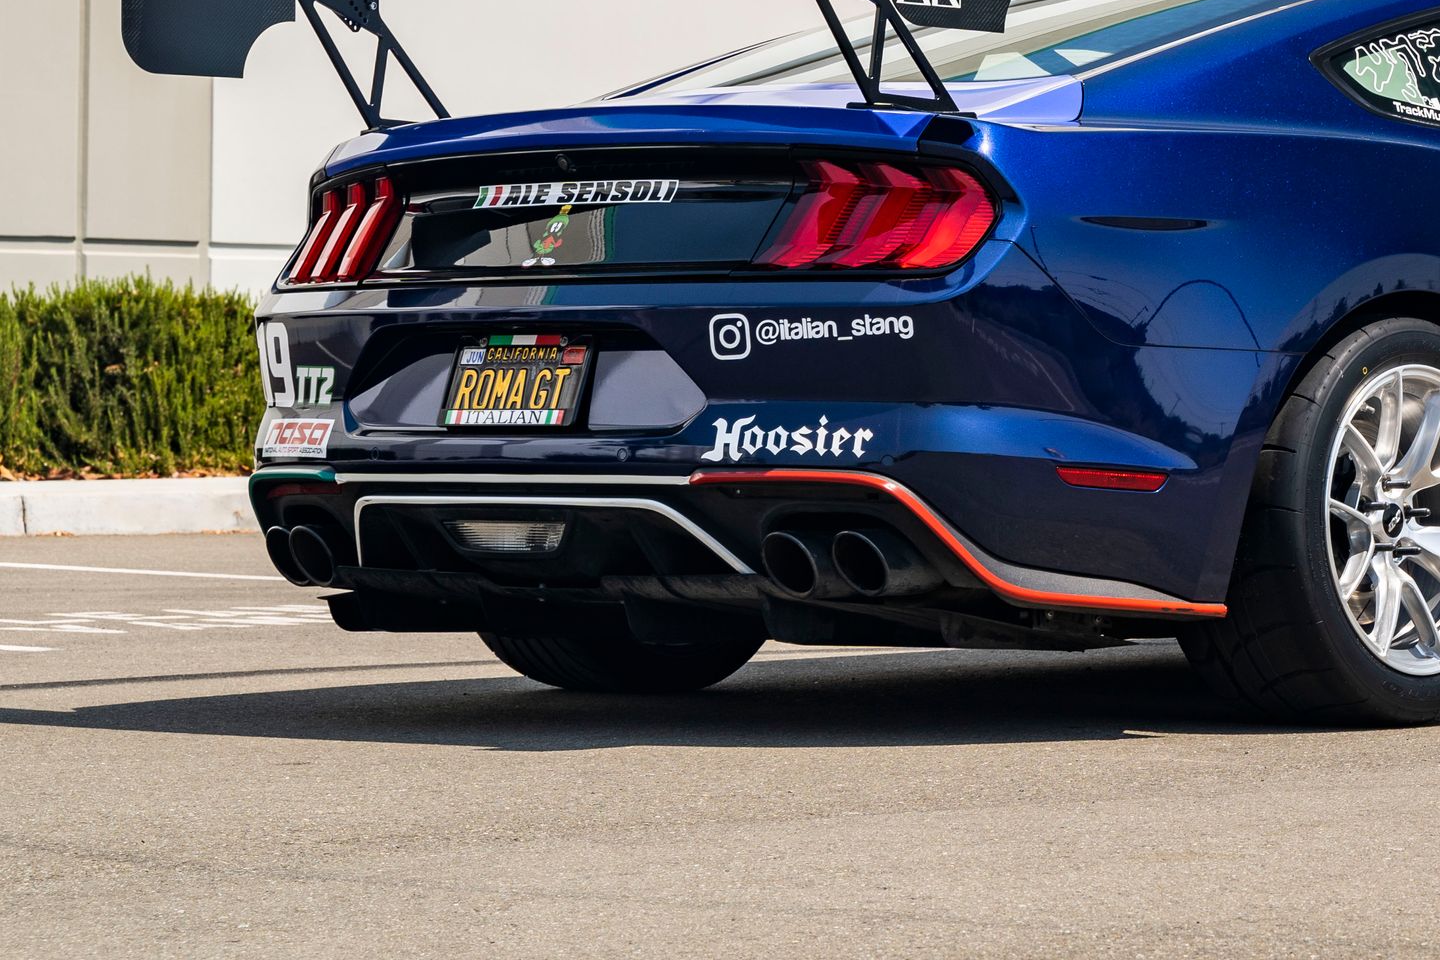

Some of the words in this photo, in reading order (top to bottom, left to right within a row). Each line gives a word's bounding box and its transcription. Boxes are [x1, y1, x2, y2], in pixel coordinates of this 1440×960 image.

[502, 183, 552, 206] ALE
[556, 181, 678, 204] SENSOLI
[755, 314, 915, 346] @italian_stang
[257, 322, 296, 408] 19
[466, 350, 485, 363] JUN
[486, 347, 559, 361] CALIFORNIA
[296, 366, 336, 406] TT2
[453, 368, 528, 410] ROMA
[529, 368, 572, 410] GT
[465, 410, 543, 424] ITALIAN
[700, 414, 874, 463] Hoosier
